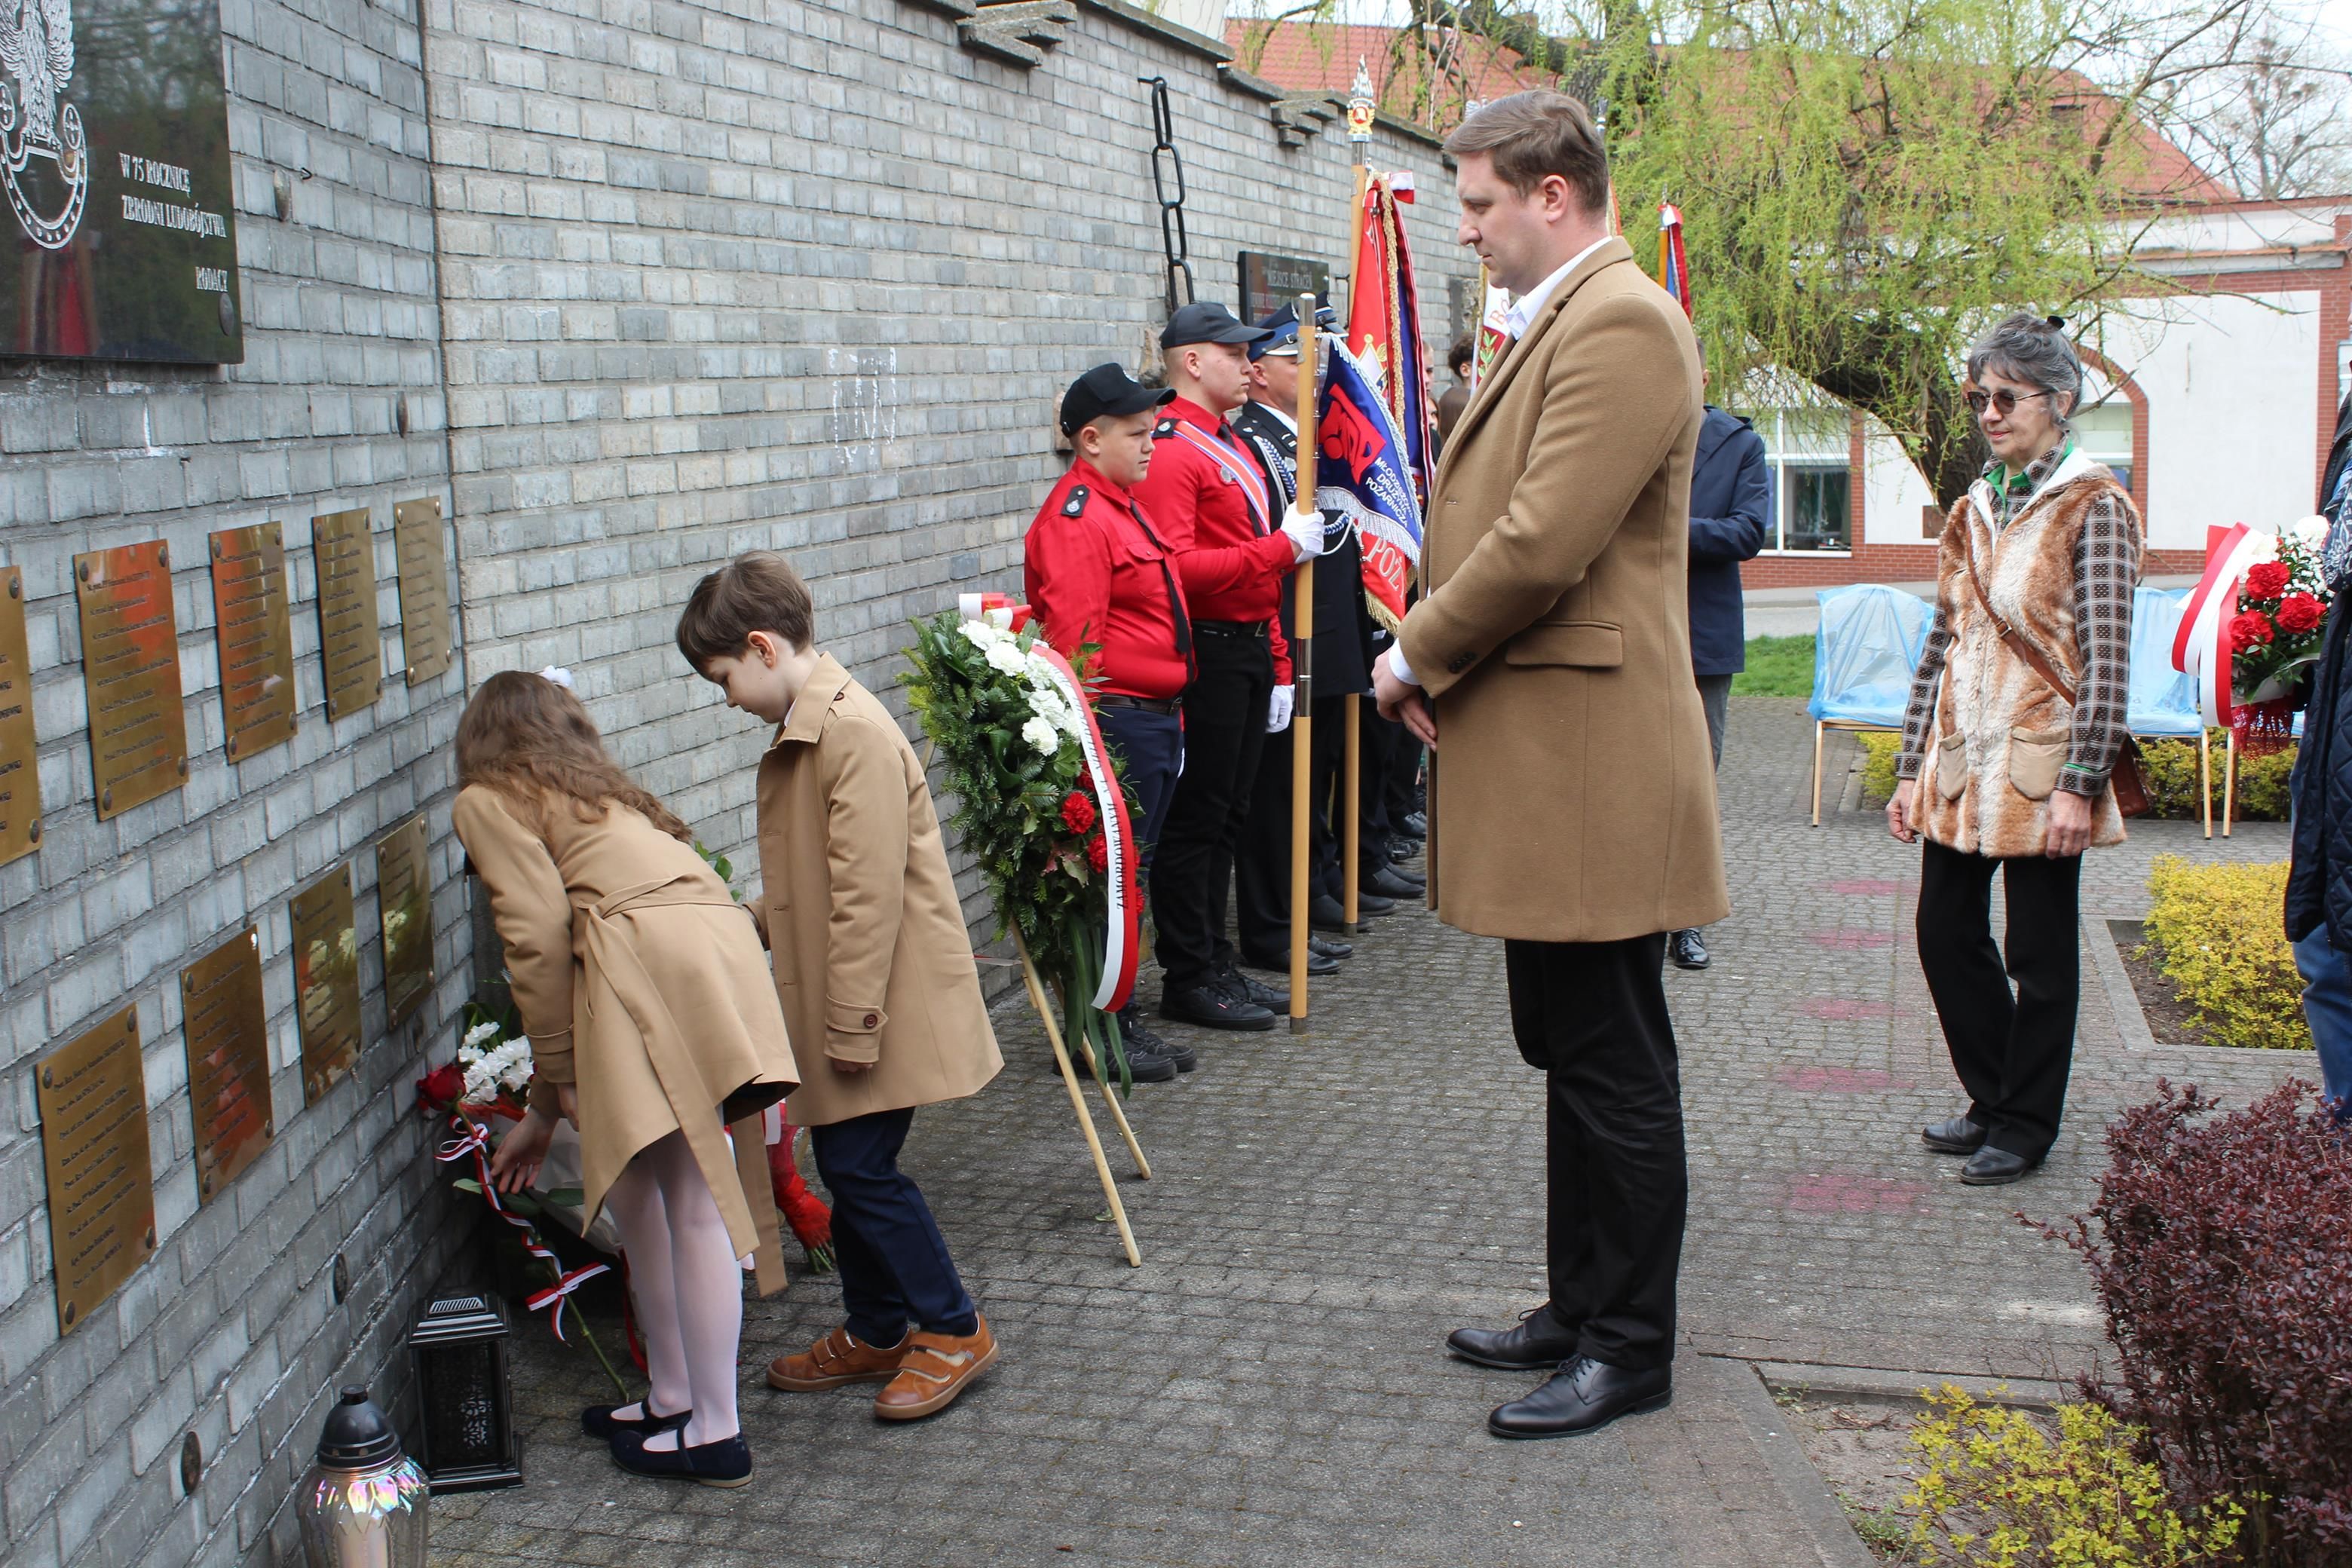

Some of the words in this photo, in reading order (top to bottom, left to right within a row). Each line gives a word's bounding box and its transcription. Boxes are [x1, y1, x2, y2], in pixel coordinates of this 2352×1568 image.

[119, 152, 130, 179] W
[132, 155, 144, 182] 75
[145, 159, 191, 199] ROCZNICĘ
[121, 194, 165, 226] ZBRODNI
[165, 202, 227, 238] LUDOBÓJSTWA
[195, 266, 228, 292] RODACY
[1365, 476, 1408, 528] POŻARNICZA
